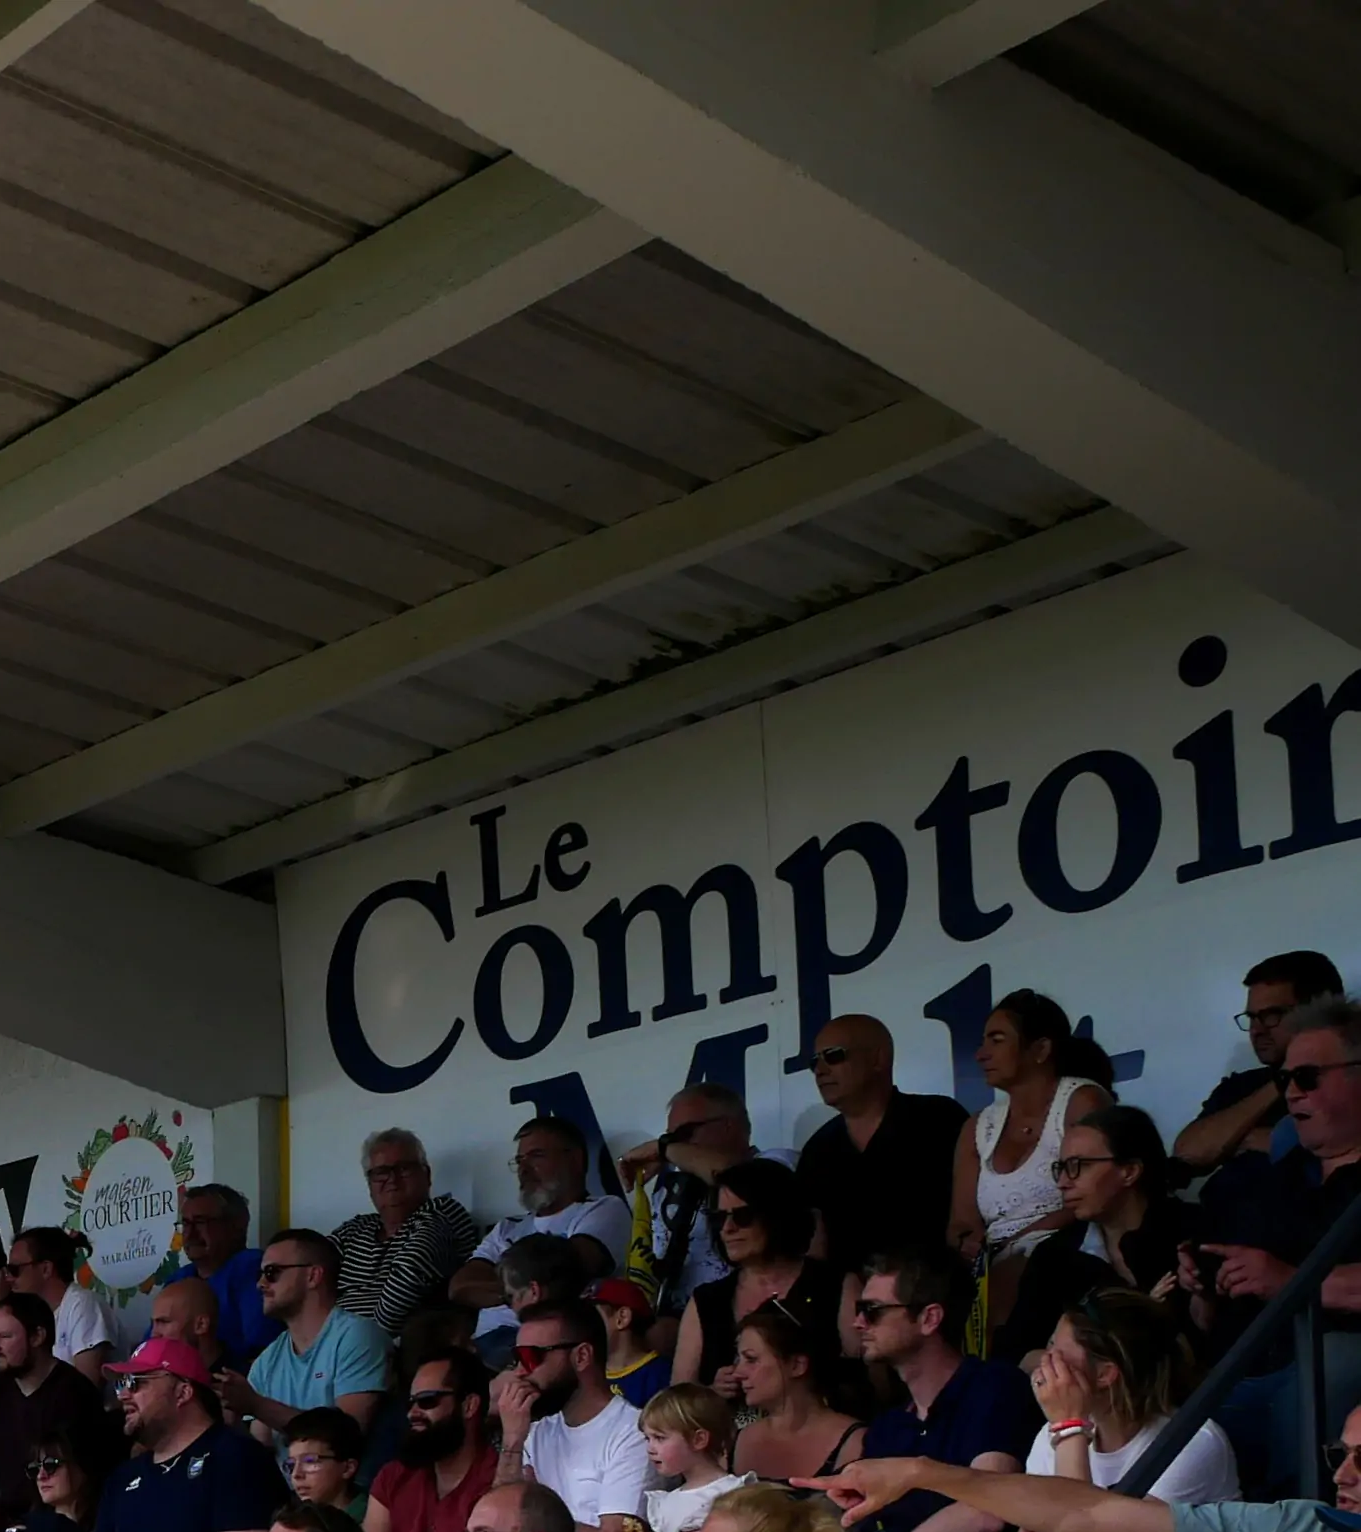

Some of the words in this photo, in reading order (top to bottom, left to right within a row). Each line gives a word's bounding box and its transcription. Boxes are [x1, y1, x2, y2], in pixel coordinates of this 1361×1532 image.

[326, 634, 1361, 1094] Comptoir
[470, 805, 591, 918] Le
[83, 1190, 175, 1233] COURTIER
[95, 1173, 154, 1206] maison
